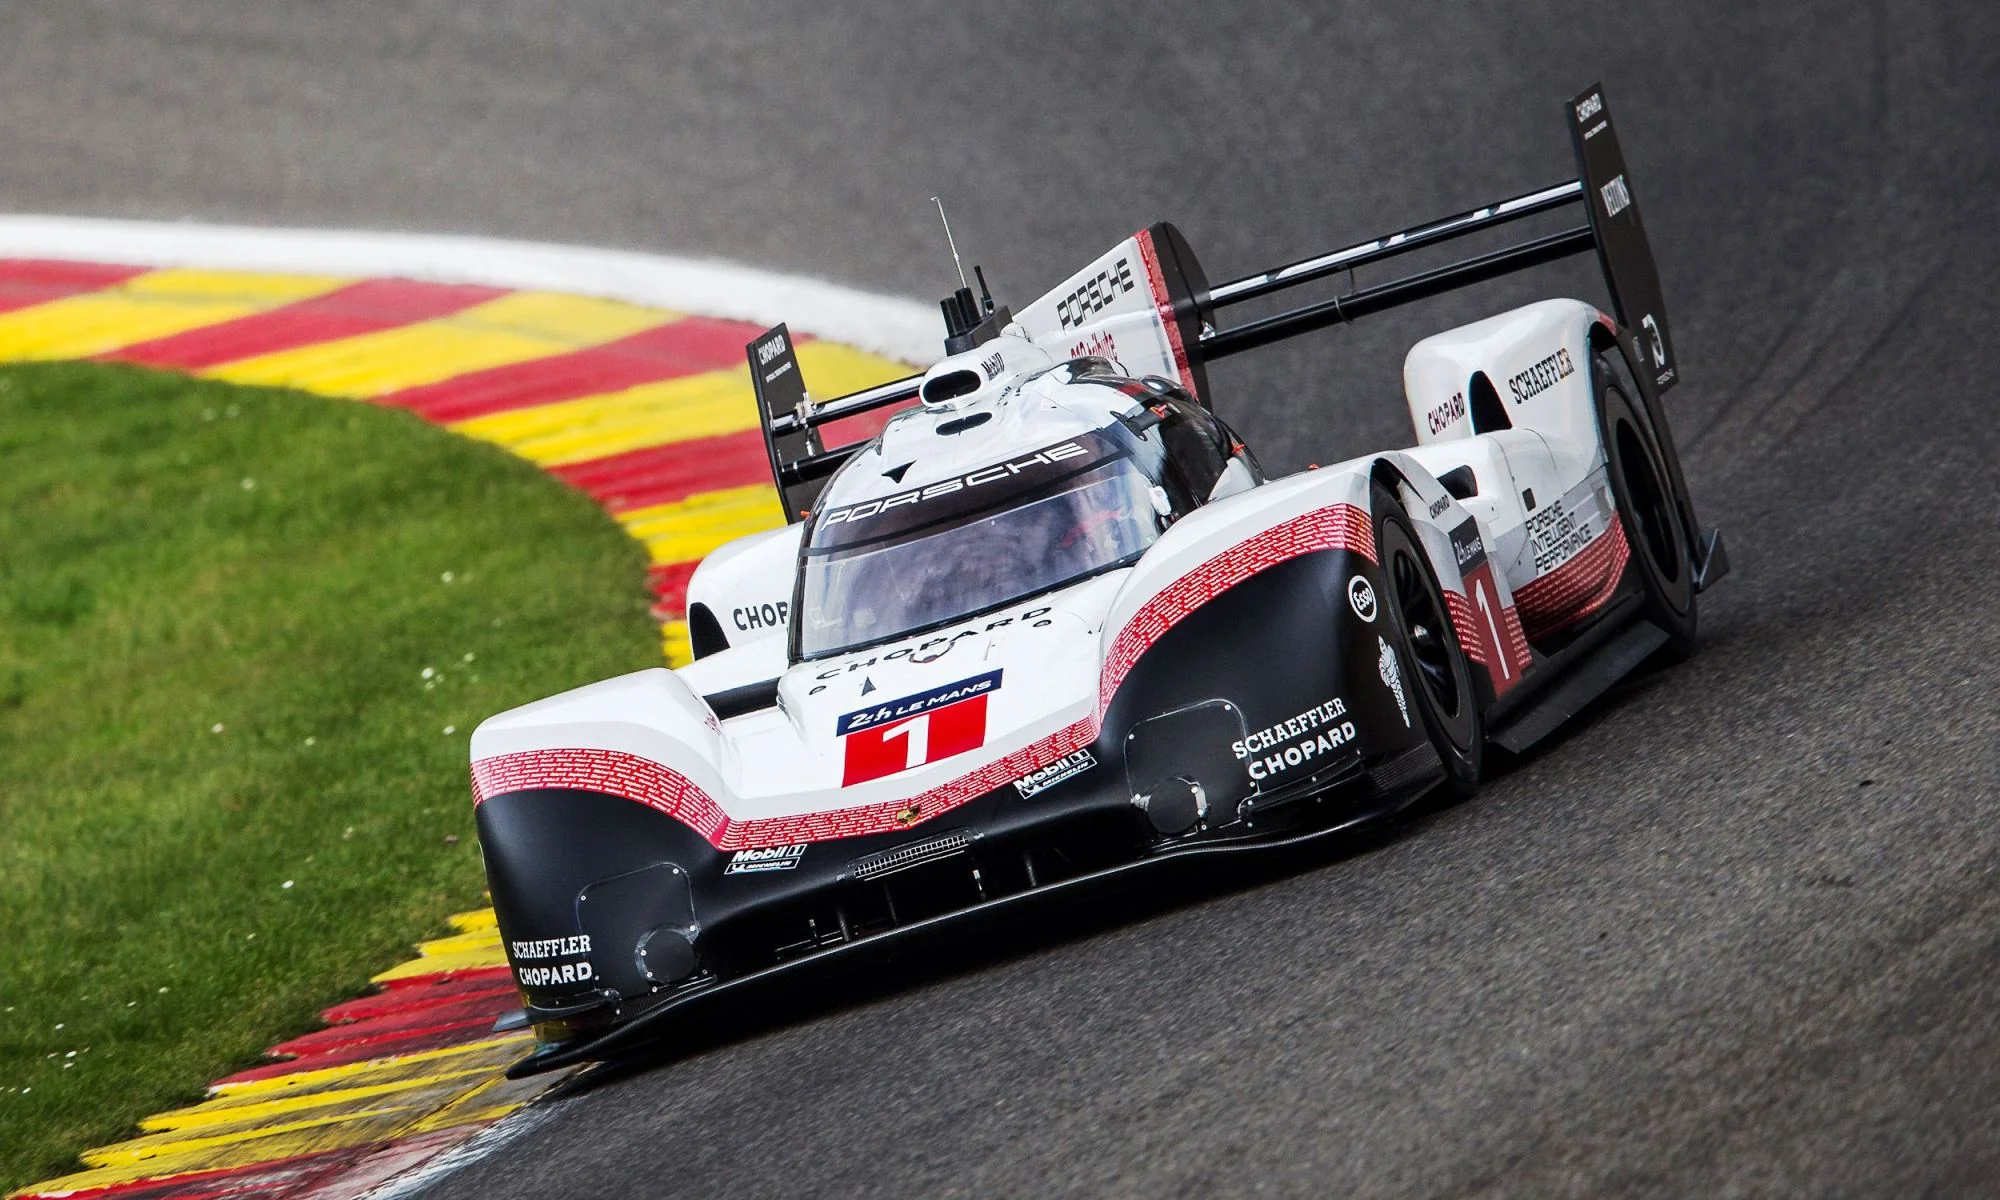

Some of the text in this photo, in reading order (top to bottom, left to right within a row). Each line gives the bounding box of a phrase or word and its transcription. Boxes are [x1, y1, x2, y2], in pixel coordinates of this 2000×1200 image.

[1057, 258, 1135, 331] PORSCHE
[758, 334, 786, 366] CHOPARD
[1508, 348, 1575, 404] SCHAEFFLER
[1428, 392, 1465, 435] CHOPARD
[821, 442, 1090, 530] PORSCHE
[1525, 500, 1564, 537] PORSCHE
[1531, 512, 1577, 556] INTELLIGENT
[733, 601, 788, 631] CHOP
[1475, 579, 1510, 680] 1
[816, 607, 1052, 680] CHOPARD
[896, 701, 924, 714] LE
[926, 680, 992, 707] MANS
[882, 714, 929, 769] 1
[1232, 697, 1347, 760] SCHAEFFLER
[1248, 721, 1356, 780] CHOPARD
[1013, 758, 1070, 791] Mobil
[731, 846, 788, 863] Mobil
[512, 935, 592, 960] SCHAEFFLER
[519, 962, 593, 986] CHOPARD
